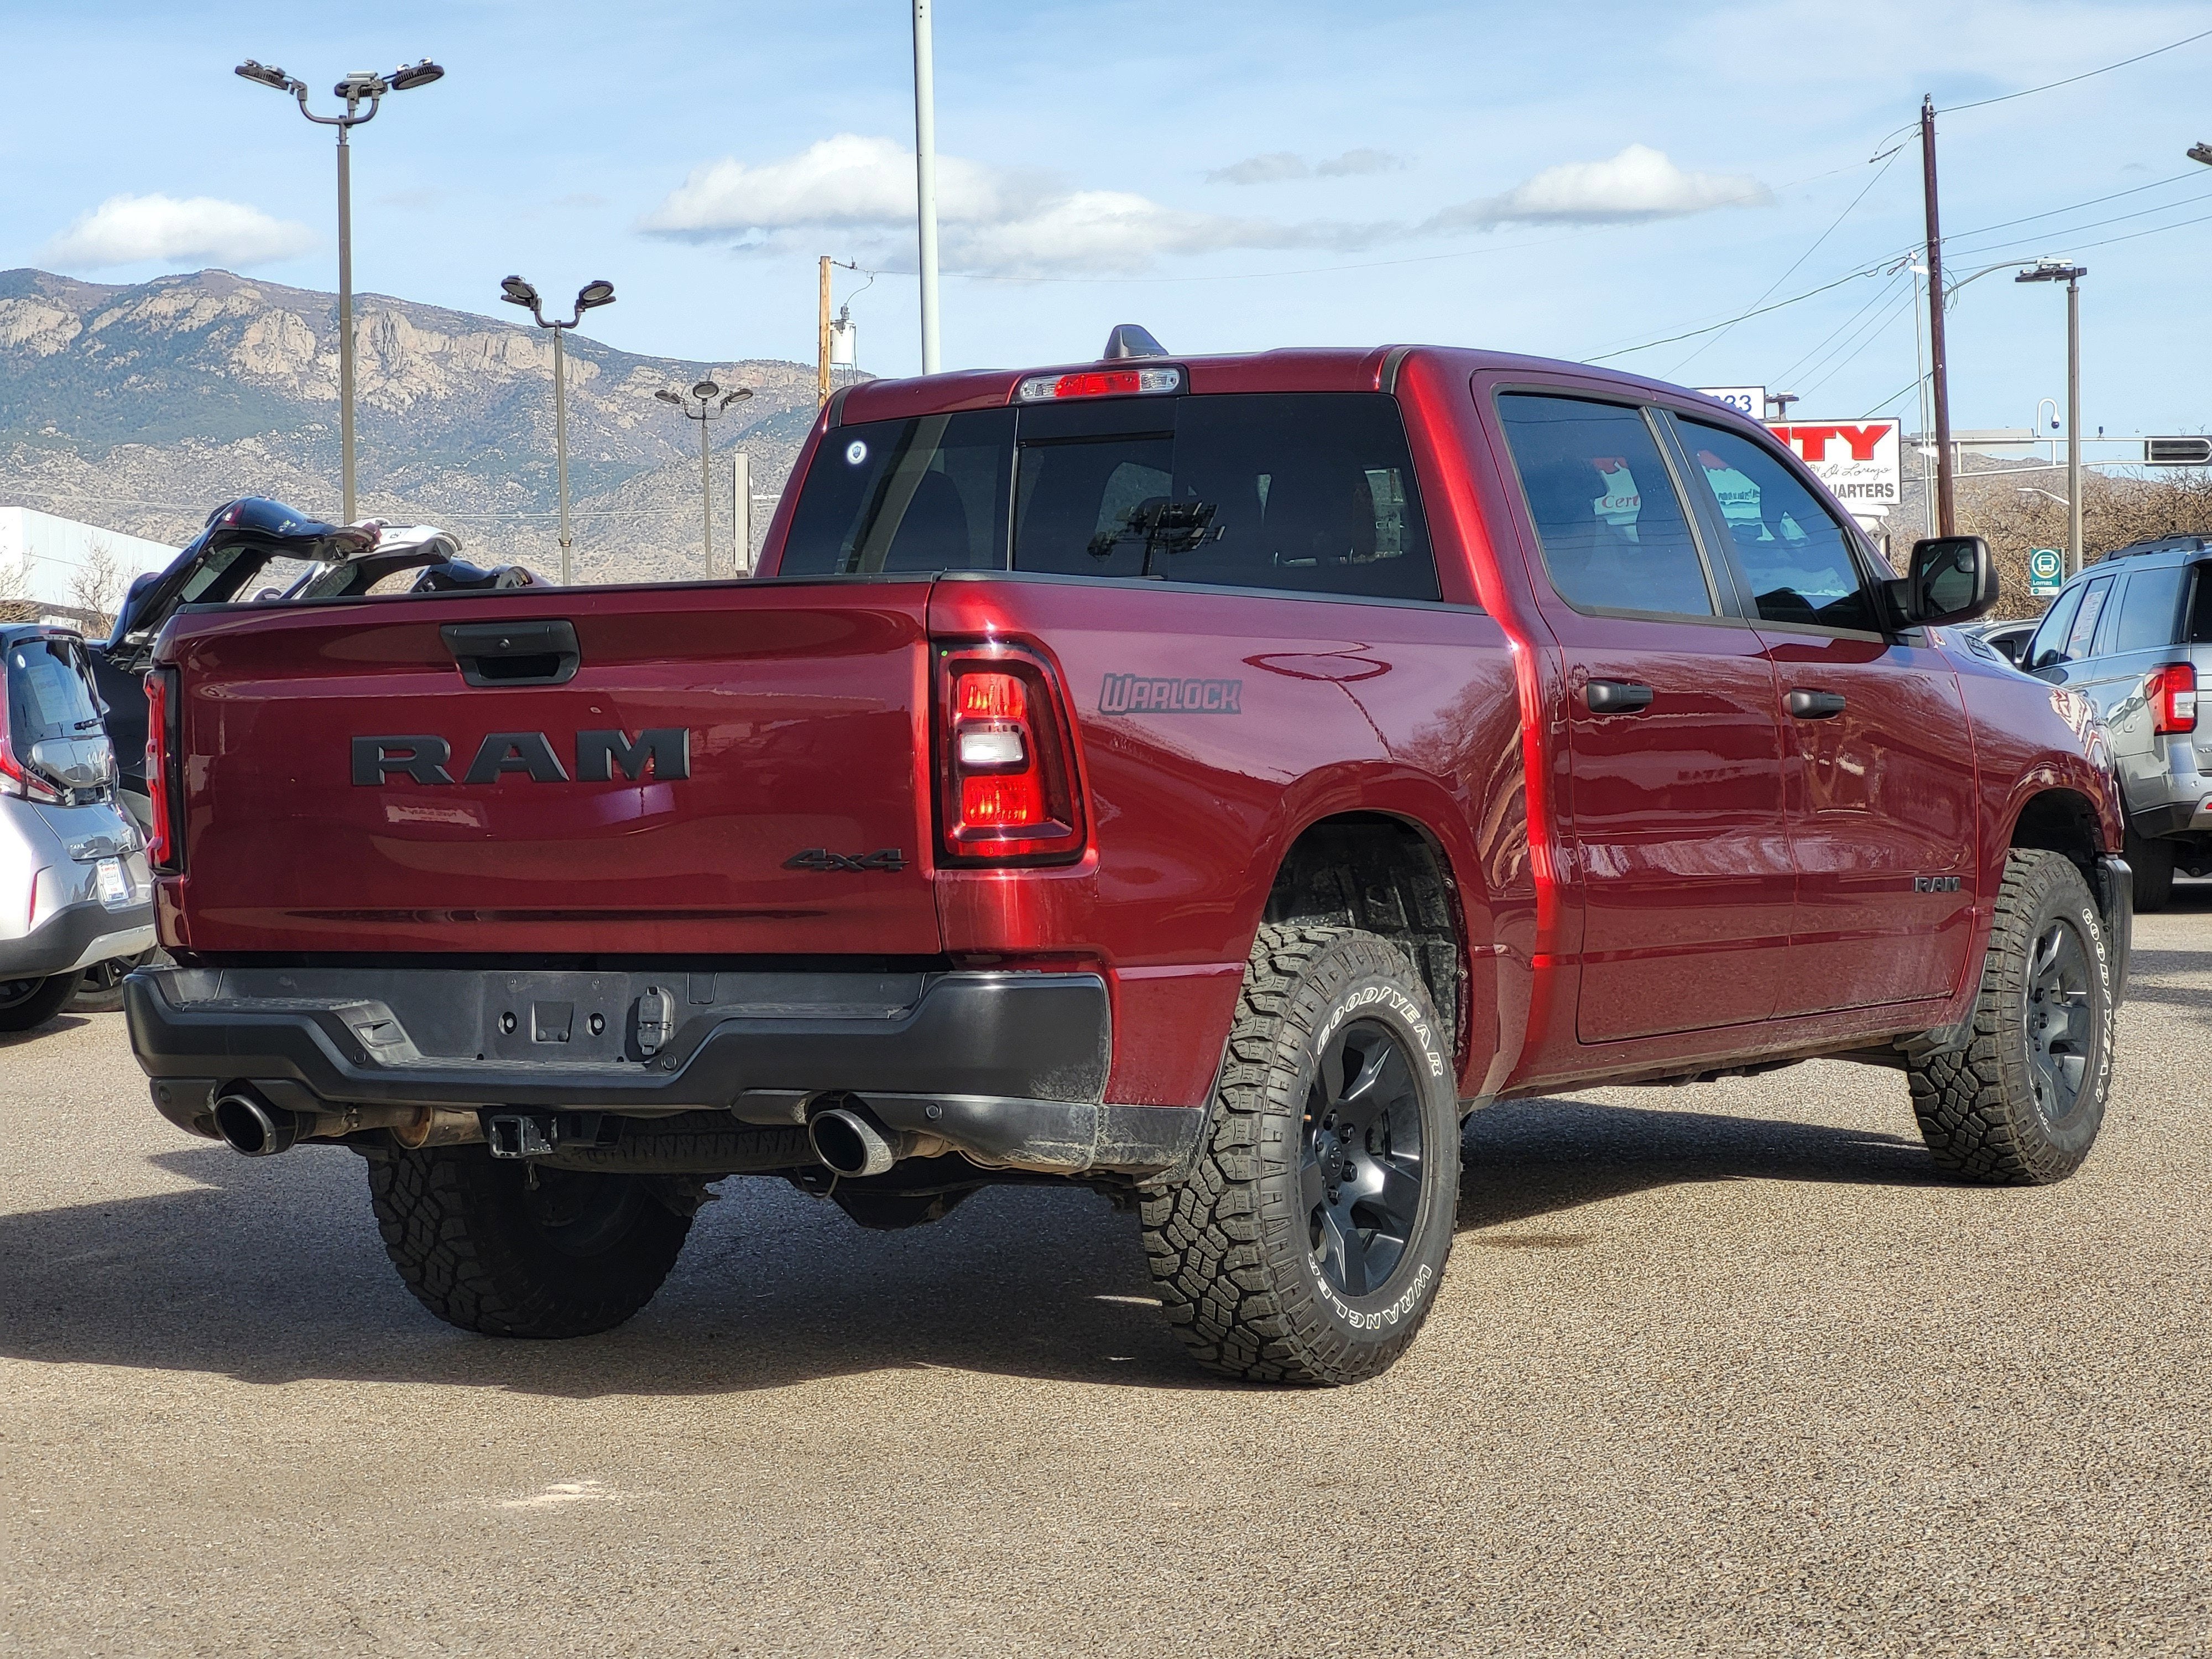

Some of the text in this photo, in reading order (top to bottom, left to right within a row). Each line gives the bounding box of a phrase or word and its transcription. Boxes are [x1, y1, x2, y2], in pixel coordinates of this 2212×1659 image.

[1099, 673, 1243, 715] WARLOCK
[352, 727, 691, 785] RAM
[781, 848, 910, 872] 4x4
[1914, 877, 1961, 893] RAM
[1317, 986, 1443, 1077] GOODYEAR
[2082, 909, 2114, 1104] GOODYEAR
[1308, 1251, 1433, 1330] WRANGLER
